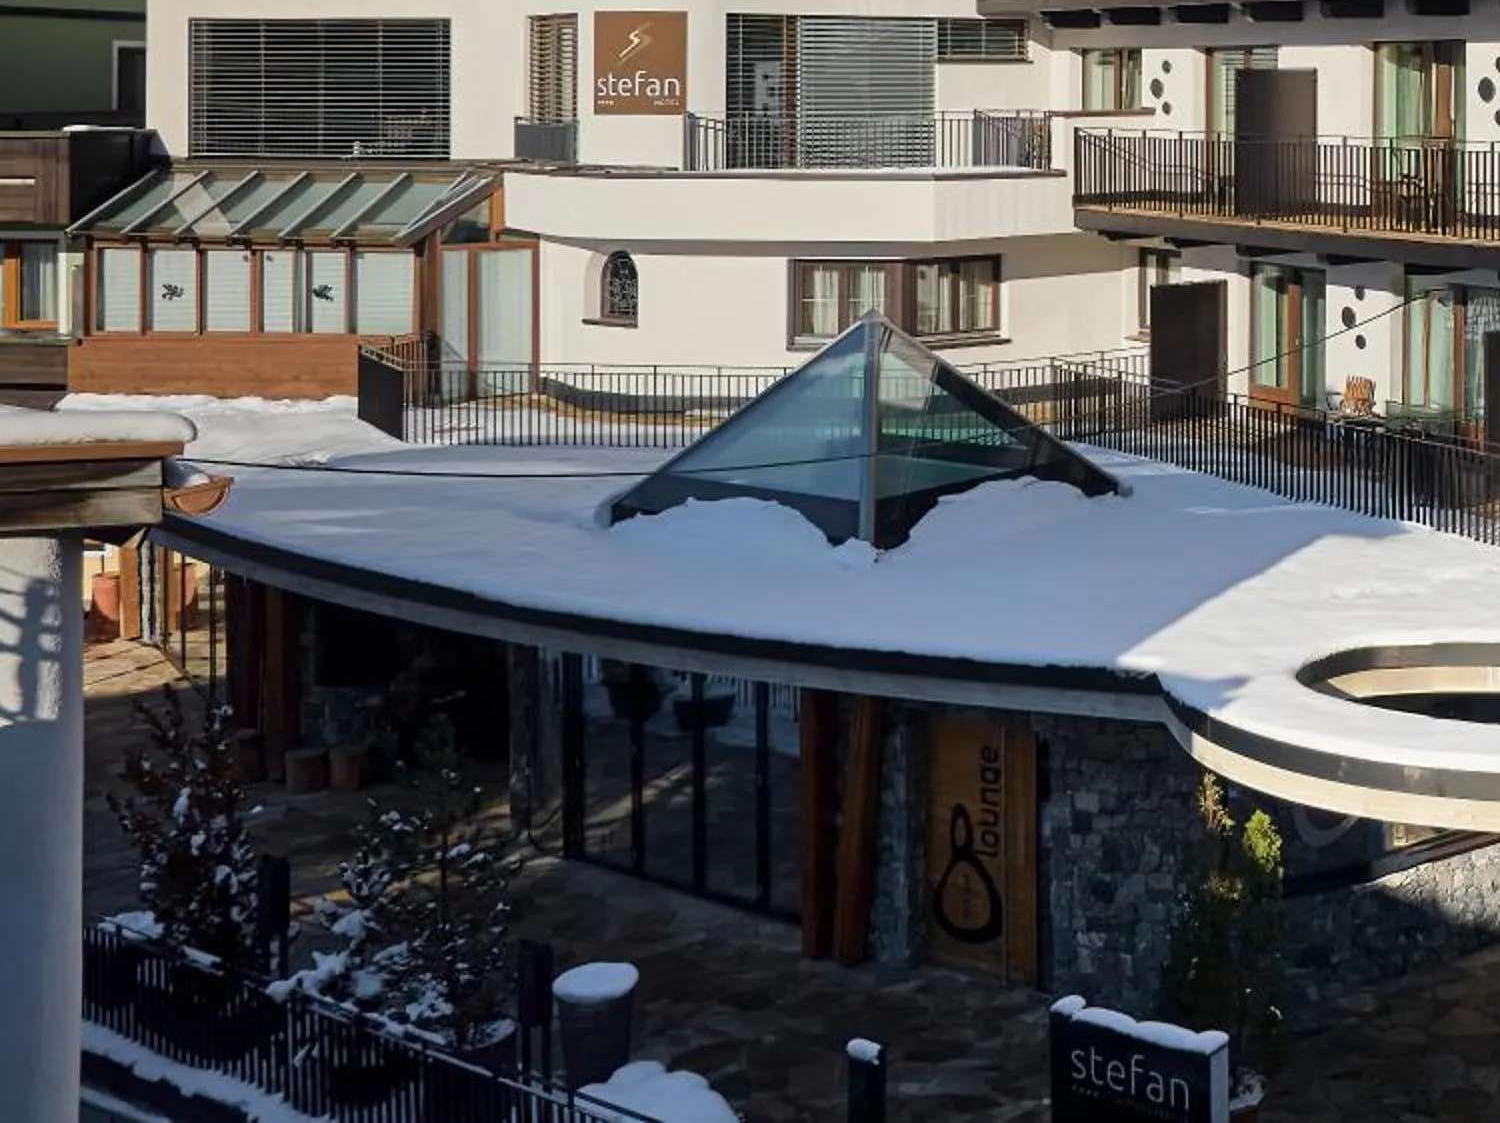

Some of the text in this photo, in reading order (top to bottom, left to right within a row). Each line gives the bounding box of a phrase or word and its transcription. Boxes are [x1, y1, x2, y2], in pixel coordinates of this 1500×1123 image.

[597, 70, 680, 96] stefan
[975, 745, 1000, 859] lounge
[1070, 1046, 1189, 1111] stefan
